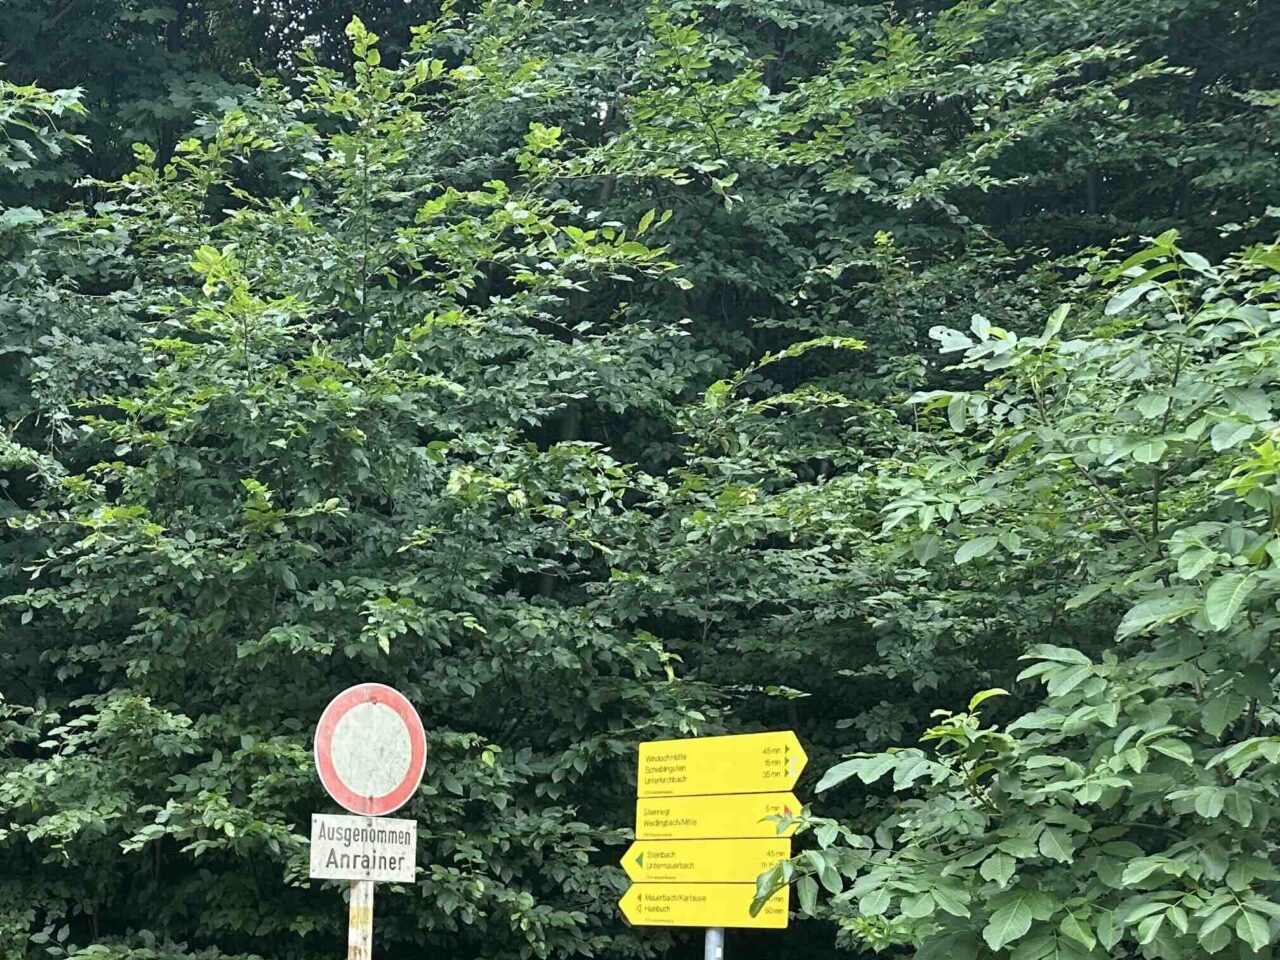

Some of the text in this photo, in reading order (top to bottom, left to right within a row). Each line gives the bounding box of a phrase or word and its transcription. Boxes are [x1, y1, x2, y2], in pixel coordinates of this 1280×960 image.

[318, 821, 411, 847] Ausgenommen
[325, 848, 405, 871] Anrainer
[646, 862, 696, 870] Untermauerbach
